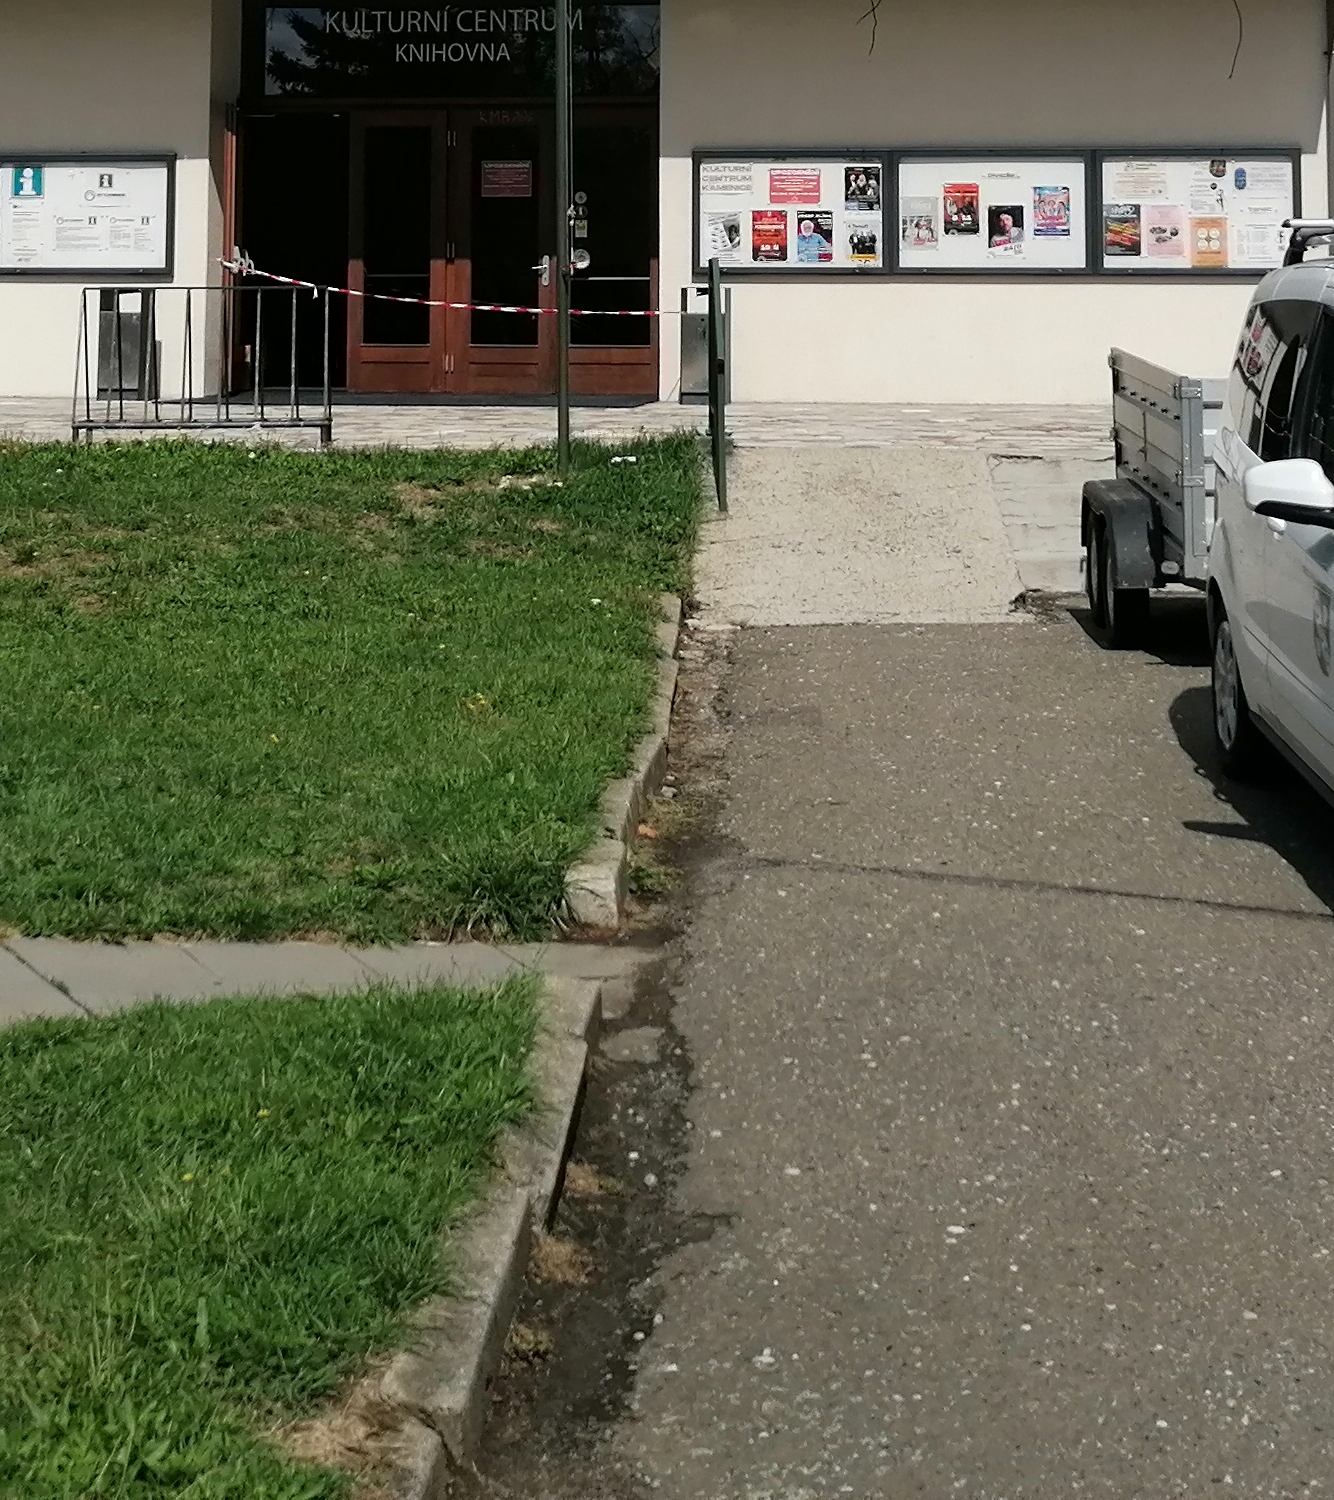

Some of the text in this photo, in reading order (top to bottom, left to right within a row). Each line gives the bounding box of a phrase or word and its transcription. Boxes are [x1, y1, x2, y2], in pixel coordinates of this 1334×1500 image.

[325, 5, 584, 33] KULTURNÍ CENTRUM
[395, 42, 511, 63] KNIHOVNA
